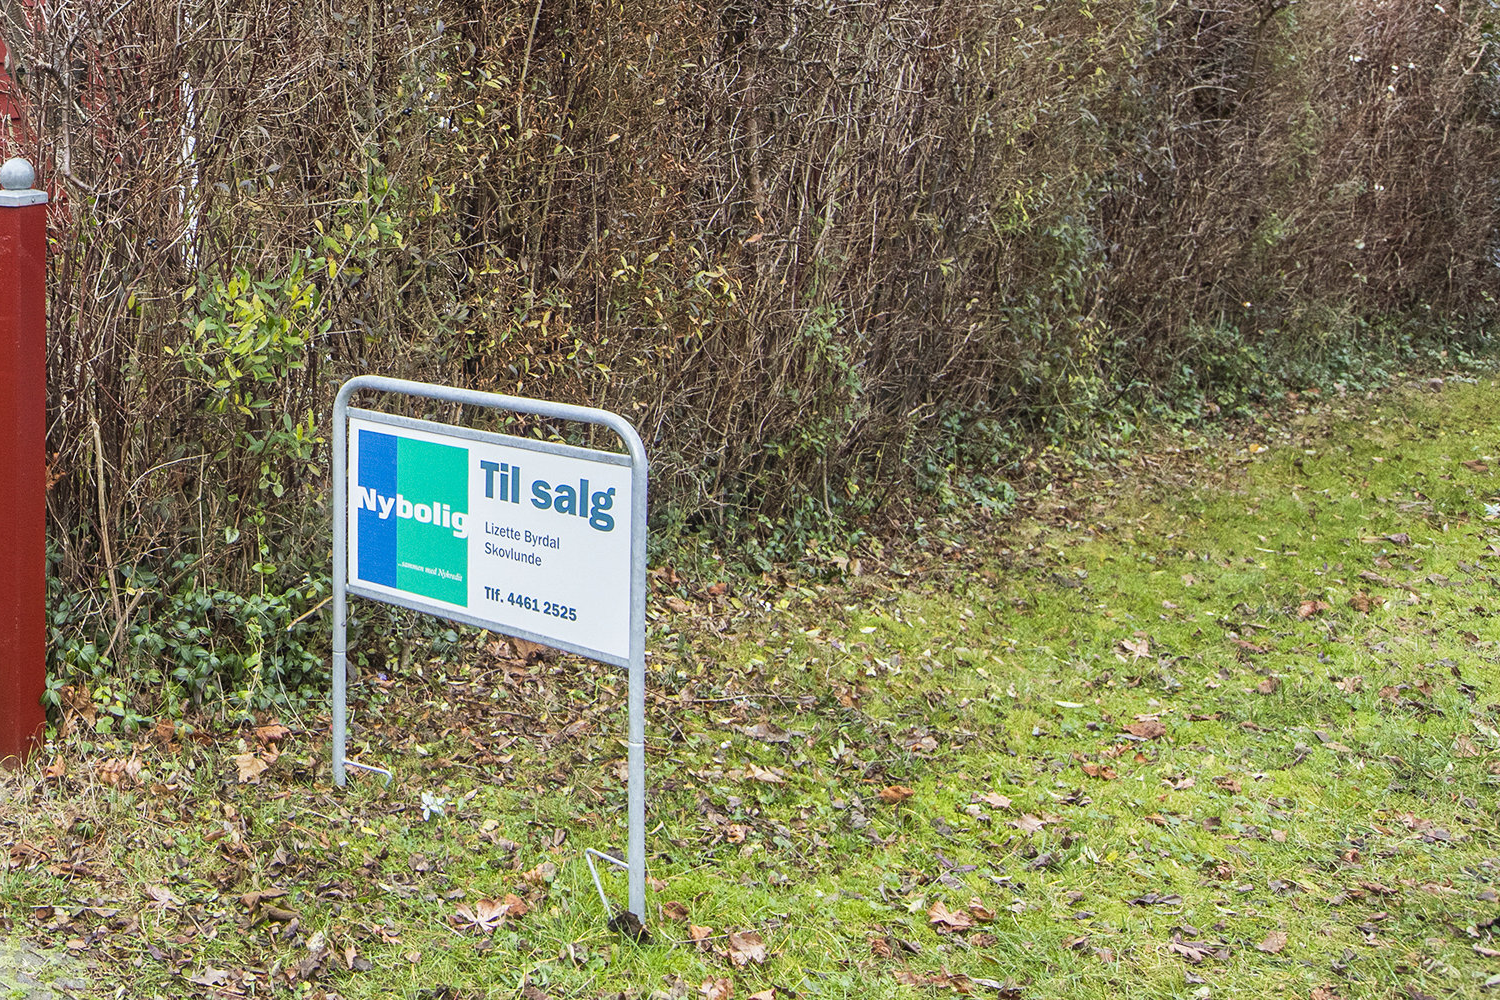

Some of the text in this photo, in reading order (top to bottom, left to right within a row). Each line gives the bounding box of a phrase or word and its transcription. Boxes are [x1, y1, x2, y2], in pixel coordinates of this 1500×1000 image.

[357, 485, 469, 539] Nybolig
[480, 459, 616, 532] Til salg
[485, 521, 560, 549] Lizette Byrdal
[484, 541, 542, 567] Skovlunde
[484, 585, 578, 622] Tlf. 4461 2525
